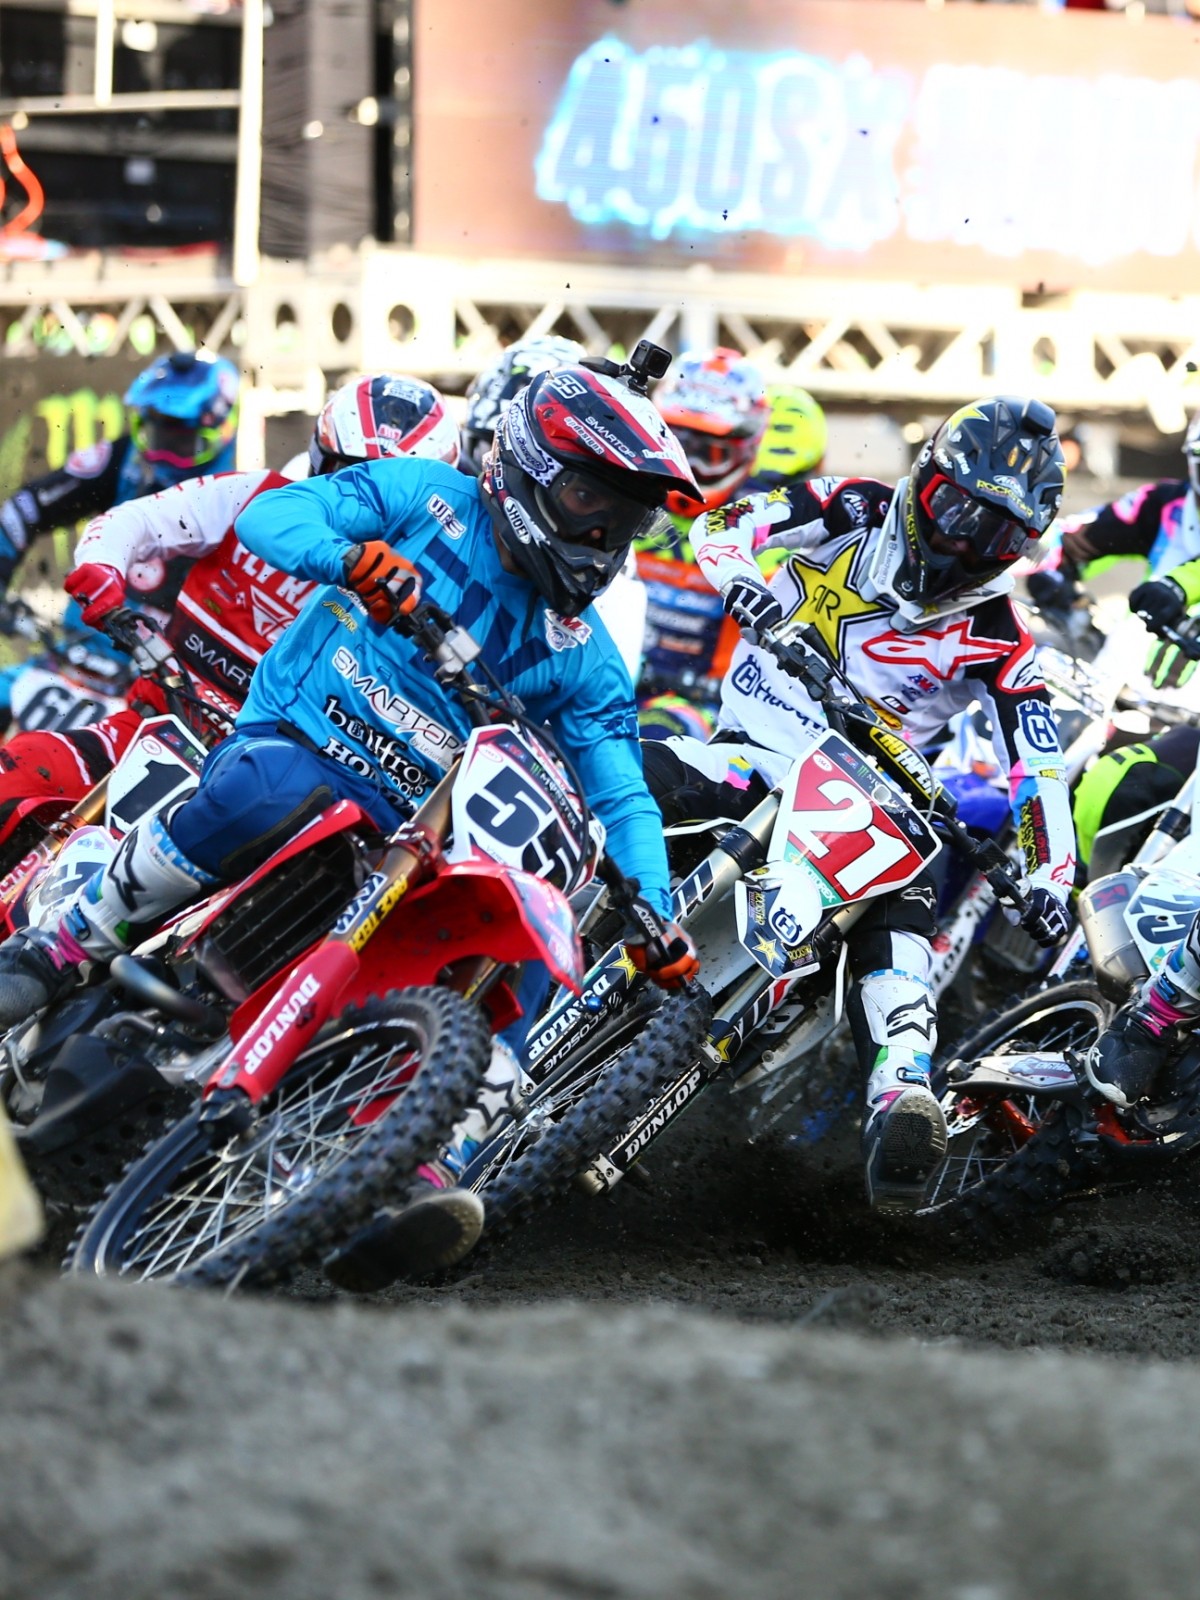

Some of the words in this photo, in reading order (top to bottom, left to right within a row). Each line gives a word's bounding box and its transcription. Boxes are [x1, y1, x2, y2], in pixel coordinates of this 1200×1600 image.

[541, 45, 905, 245] 450SX
[585, 416, 637, 459] SMARTOP
[506, 503, 531, 542] SHOEI
[184, 633, 252, 686] SMAR
[333, 648, 460, 751] SMARTOP
[325, 698, 432, 795] bullfrog
[465, 765, 582, 897] 55
[794, 779, 912, 897] 21
[632, 903, 661, 938] ARC
[244, 973, 321, 1075] DUNLOP
[624, 1070, 703, 1164] DUNLOP
